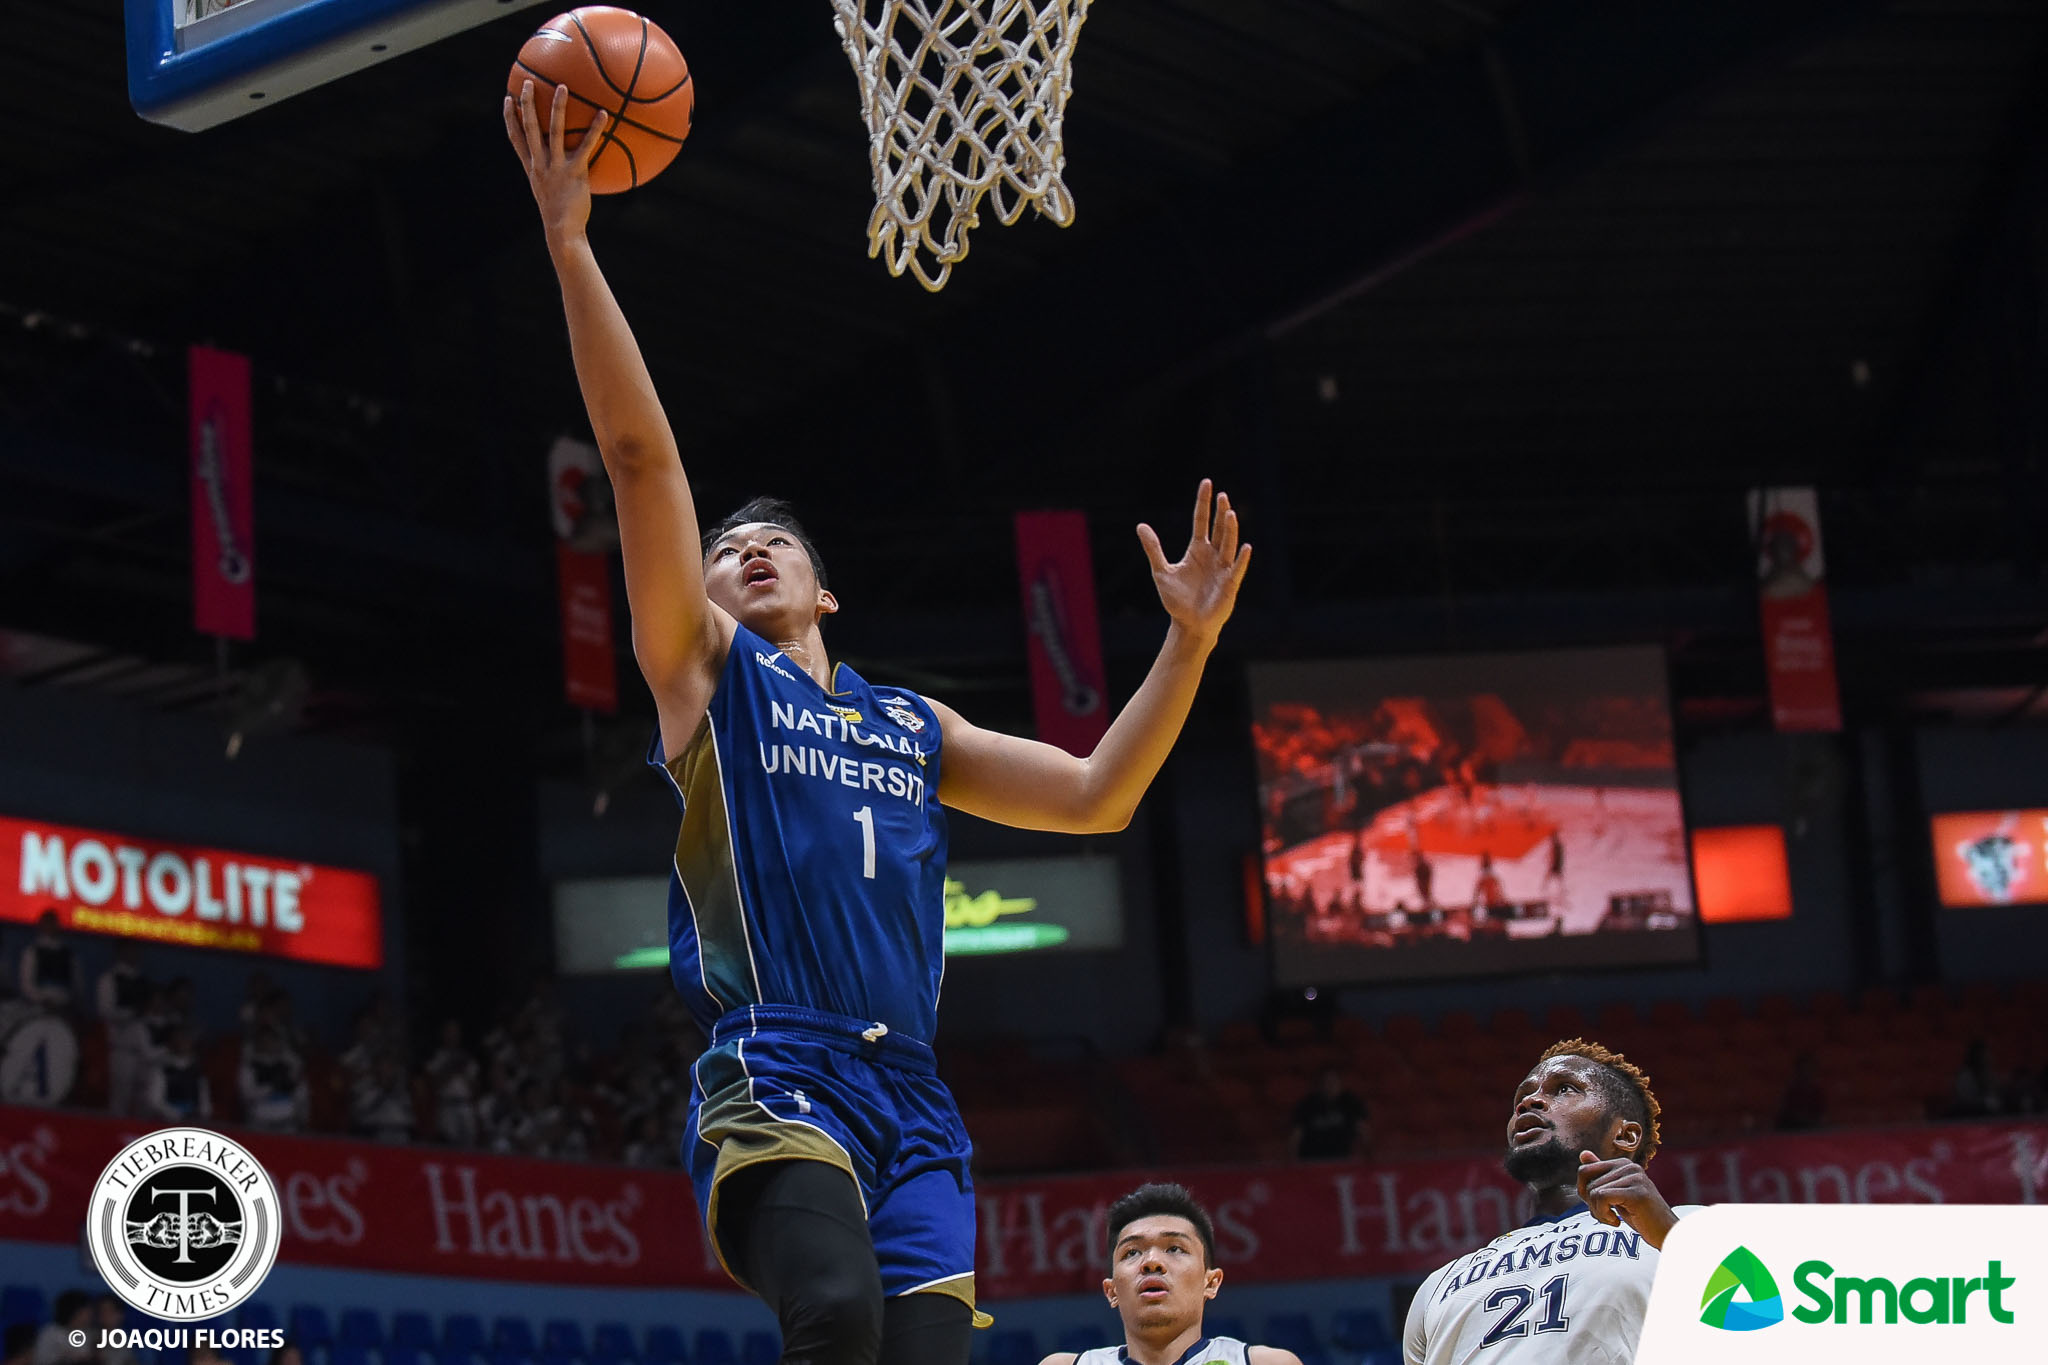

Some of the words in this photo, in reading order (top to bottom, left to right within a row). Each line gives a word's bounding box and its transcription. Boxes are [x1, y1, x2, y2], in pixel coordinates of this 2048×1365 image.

[760, 742, 925, 814] UNIVERSIT
[853, 805, 876, 880] 1
[18, 830, 306, 934] MOTOLITE
[423, 1162, 642, 1267] Hanes
[1440, 1230, 1641, 1304] ADAMSON
[1480, 1273, 1570, 1350] 21
